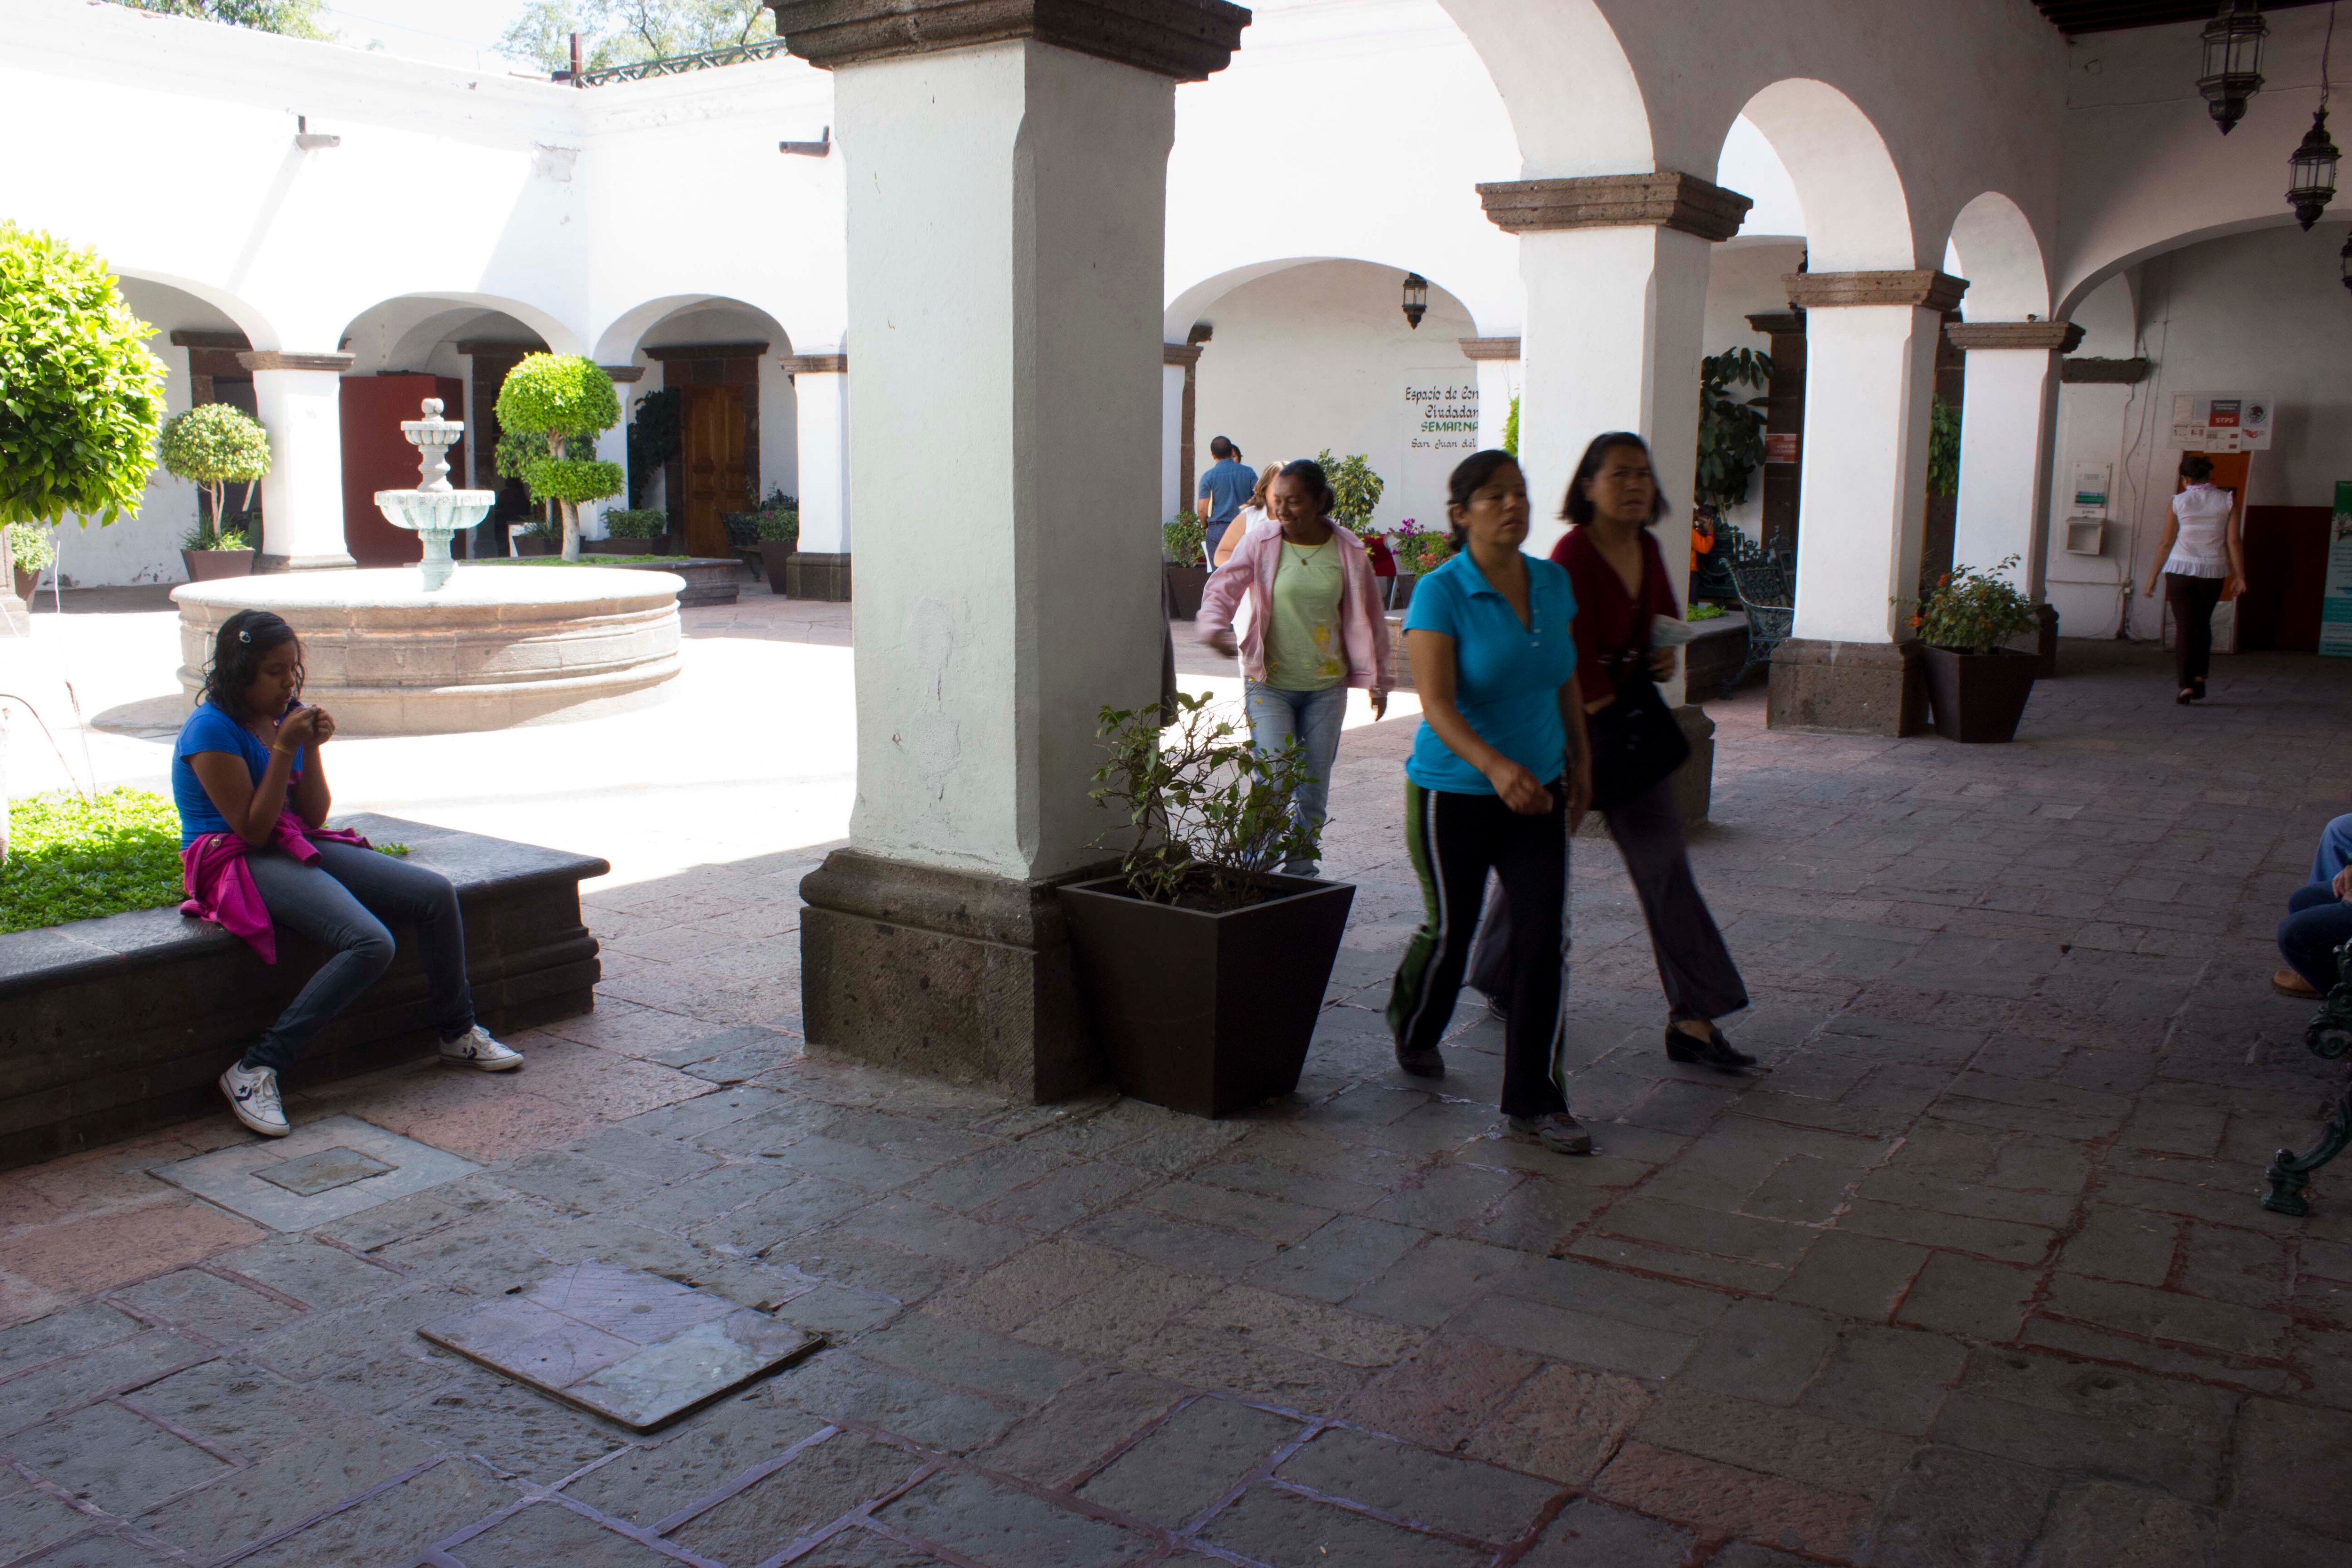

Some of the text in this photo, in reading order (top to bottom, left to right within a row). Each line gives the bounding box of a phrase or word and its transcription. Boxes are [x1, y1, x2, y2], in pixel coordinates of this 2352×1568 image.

[1406, 386, 1441, 406] Espacio
[1445, 386, 1457, 400] de
[1411, 438, 1476, 450] San Juan del
